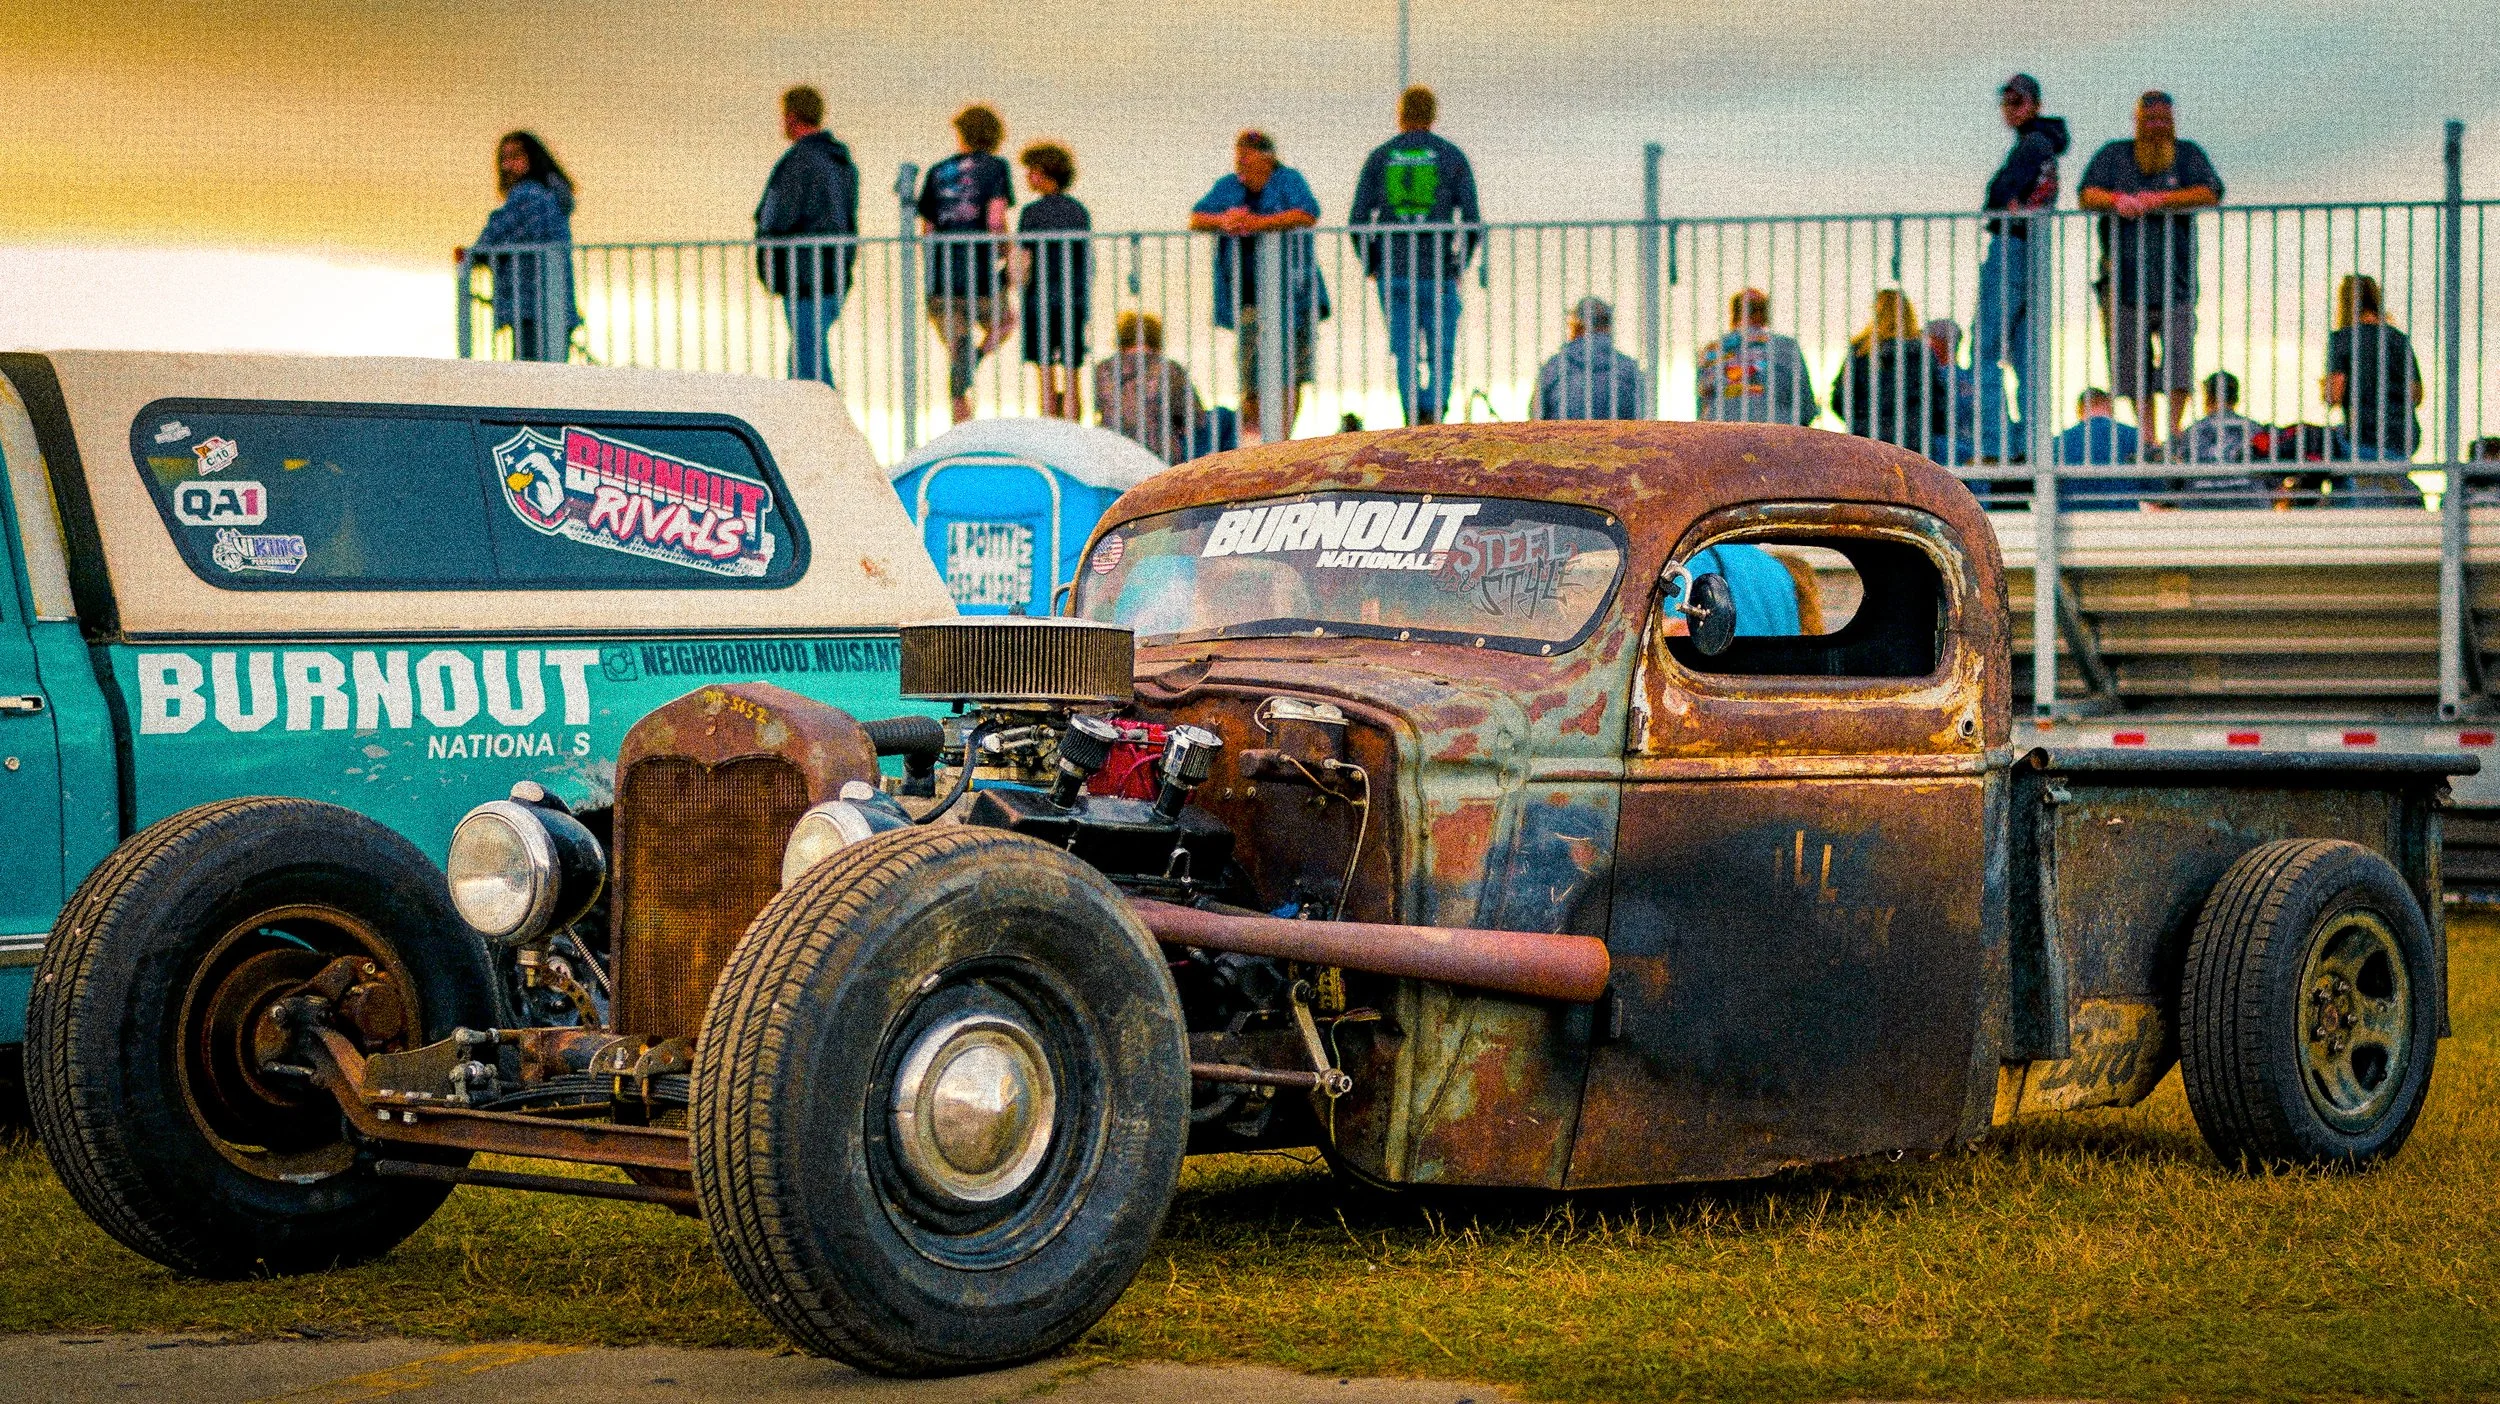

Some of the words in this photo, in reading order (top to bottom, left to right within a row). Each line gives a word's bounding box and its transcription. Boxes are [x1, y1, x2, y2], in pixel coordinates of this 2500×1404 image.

[182, 489, 258, 521] QA1
[565, 431, 765, 540] BURNOUT
[232, 537, 305, 558] VIKING
[589, 485, 746, 559] RIVALS
[1202, 500, 1482, 558] BURNOUT
[1452, 526, 1572, 575] STEEL
[138, 649, 600, 735] BURNOUT
